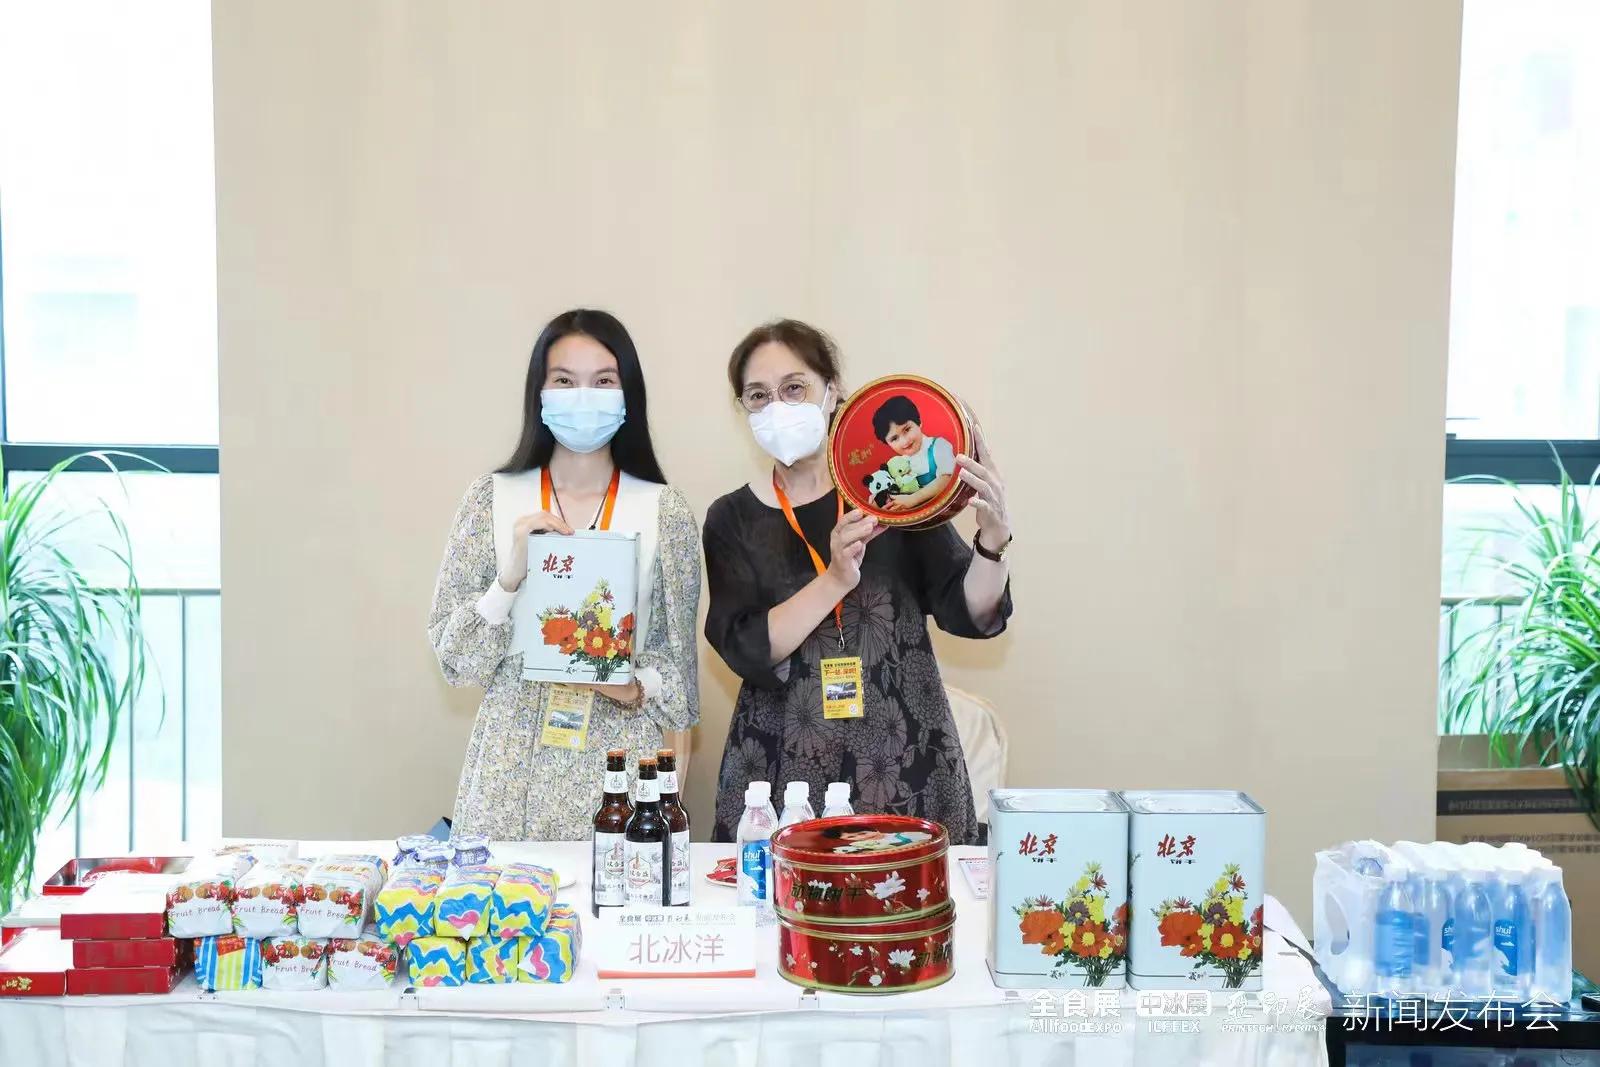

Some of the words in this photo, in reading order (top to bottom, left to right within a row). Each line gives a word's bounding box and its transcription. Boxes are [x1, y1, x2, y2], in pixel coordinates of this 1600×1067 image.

[542, 552, 575, 573] 北京
[1018, 831, 1058, 857] 北京
[1156, 833, 1196, 858] 北京
[170, 908, 193, 918] Fruit
[198, 904, 221, 914] Bread
[235, 905, 257, 913] Fruit
[261, 905, 285, 915] Bread
[300, 907, 321, 916] Fruit
[629, 933, 725, 965] 北冰洋
[275, 965, 297, 973] Fruit
[354, 960, 378, 972] Bread
